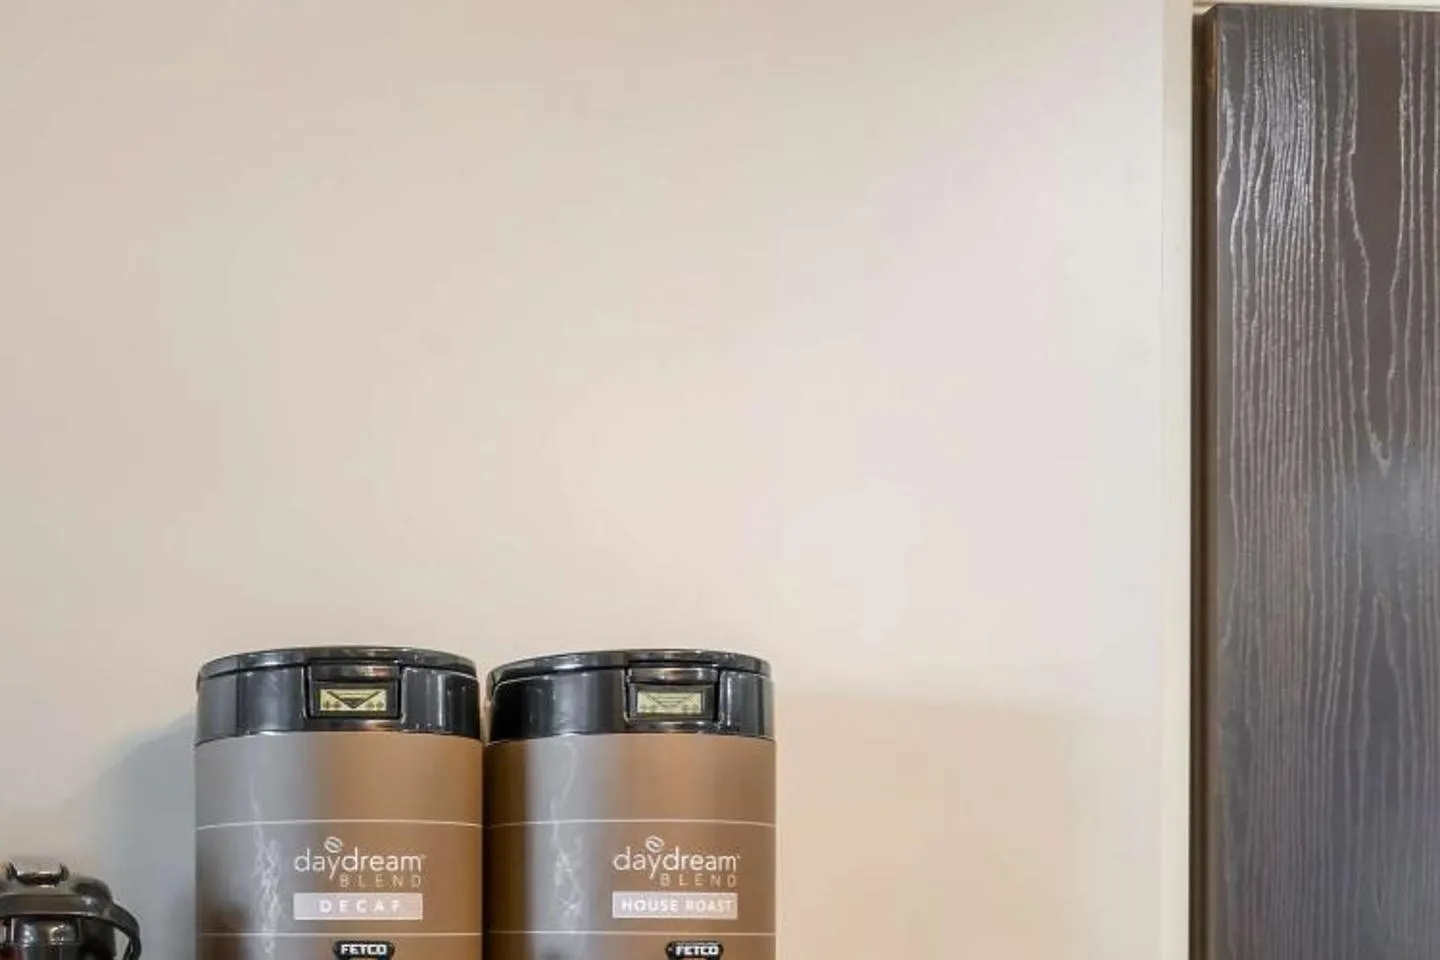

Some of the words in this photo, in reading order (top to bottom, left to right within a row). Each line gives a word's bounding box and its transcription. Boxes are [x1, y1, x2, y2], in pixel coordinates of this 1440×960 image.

[294, 846, 422, 880] daydream
[613, 846, 737, 880] daydream
[339, 874, 422, 888] BLEND
[660, 873, 737, 888] BLEND
[319, 900, 401, 913] DECAF
[620, 899, 680, 912] HOUSE
[685, 899, 732, 913] ROAST
[340, 943, 388, 956] FETCO
[675, 944, 720, 956] FETCO
